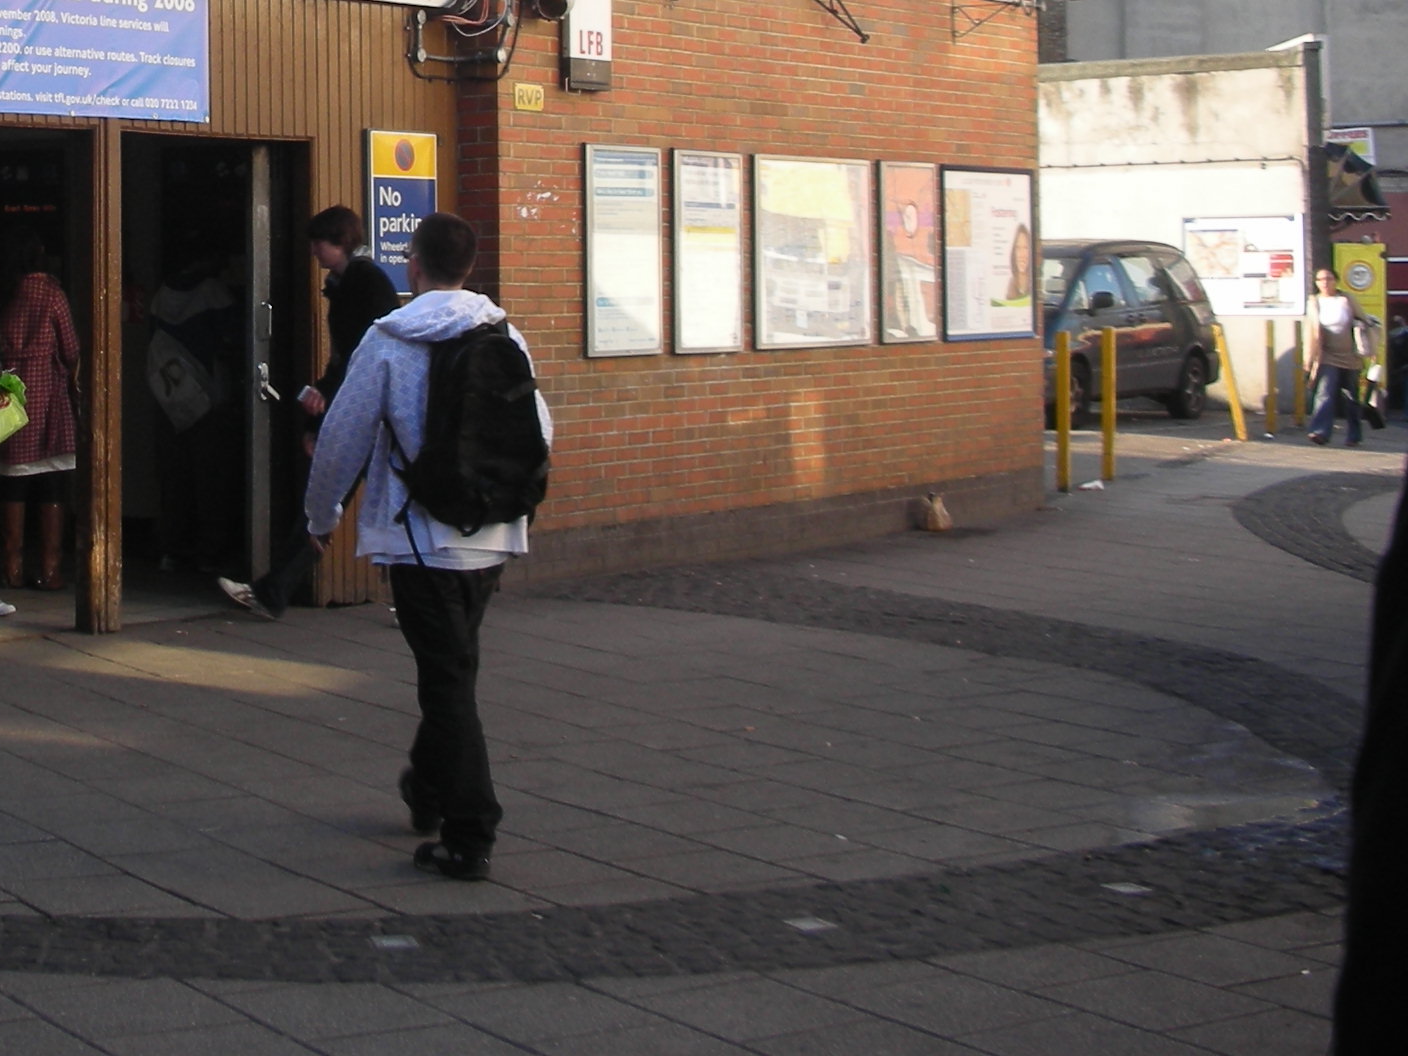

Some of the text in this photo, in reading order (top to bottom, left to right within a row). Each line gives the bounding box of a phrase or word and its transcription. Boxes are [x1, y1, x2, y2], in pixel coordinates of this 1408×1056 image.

[61, 12, 98, 27] Victoria
[100, 15, 117, 28] line
[119, 18, 152, 31] services
[154, 20, 169, 33] will
[579, 30, 603, 55] LFB
[24, 46, 34, 55] or
[36, 47, 52, 57] use
[54, 46, 105, 61] alternative
[107, 51, 138, 63] routes.
[139, 52, 162, 65] Track
[163, 55, 195, 68] closures
[1, 59, 29, 73] affect
[31, 64, 52, 75] your
[54, 64, 92, 78] journey.
[35, 91, 53, 103] visit
[121, 98, 130, 106] or
[130, 97, 144, 108] call
[517, 89, 542, 106] RVP
[379, 186, 401, 207] No
[380, 254, 388, 263] in
